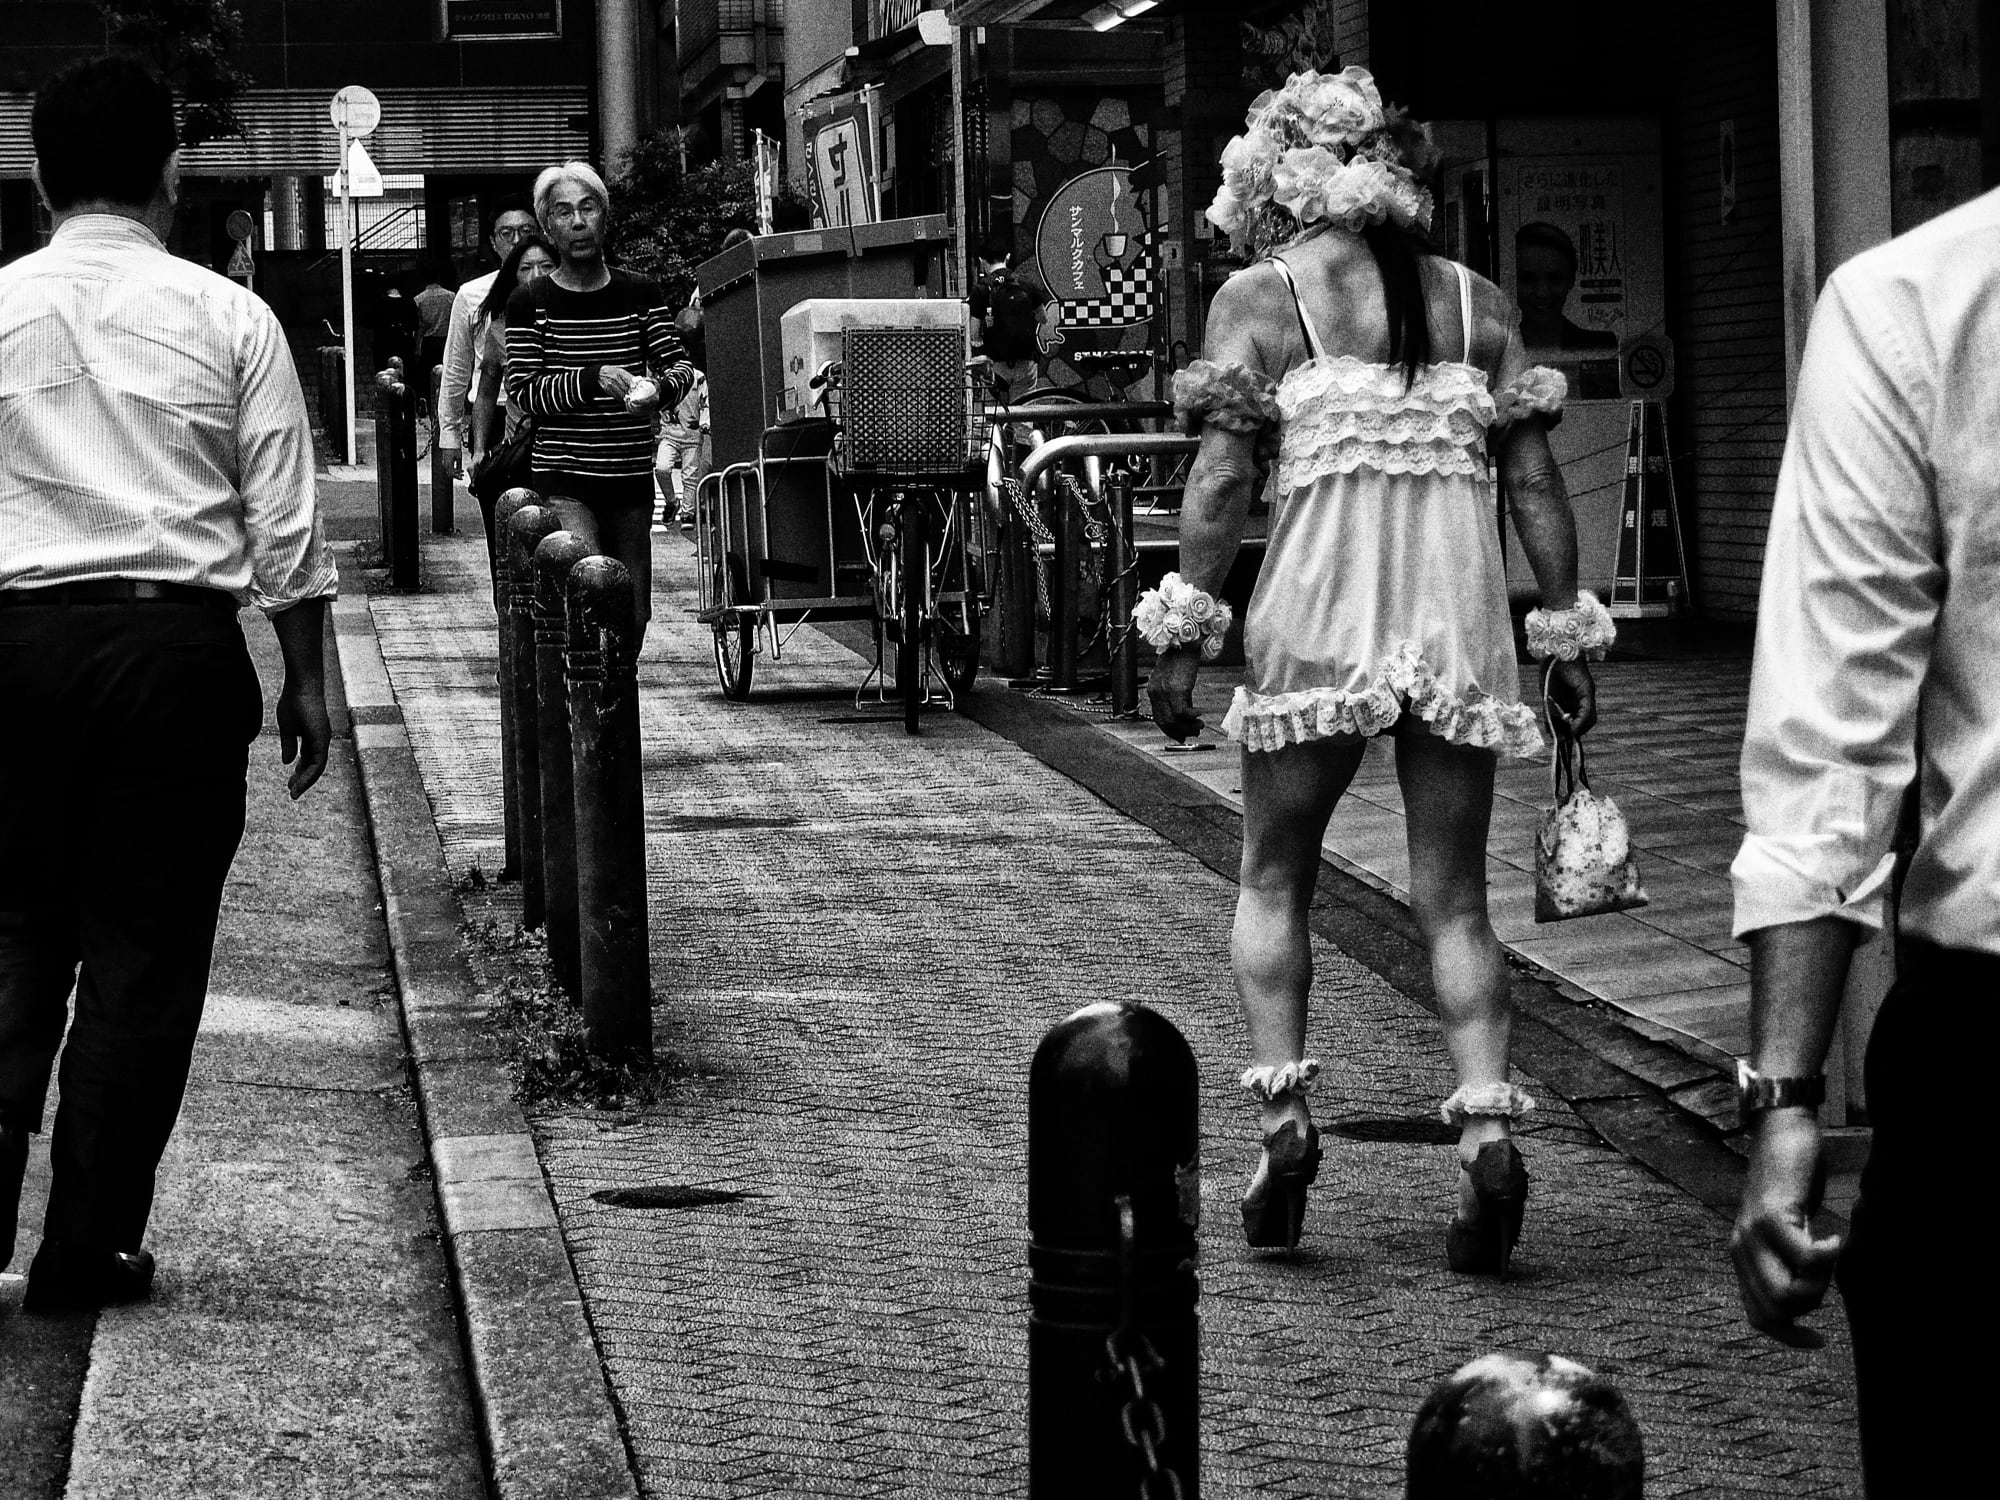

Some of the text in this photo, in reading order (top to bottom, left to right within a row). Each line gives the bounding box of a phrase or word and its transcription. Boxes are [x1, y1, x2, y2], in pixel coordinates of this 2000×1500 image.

[1069, 205, 1085, 290] サンマルクカフェ
